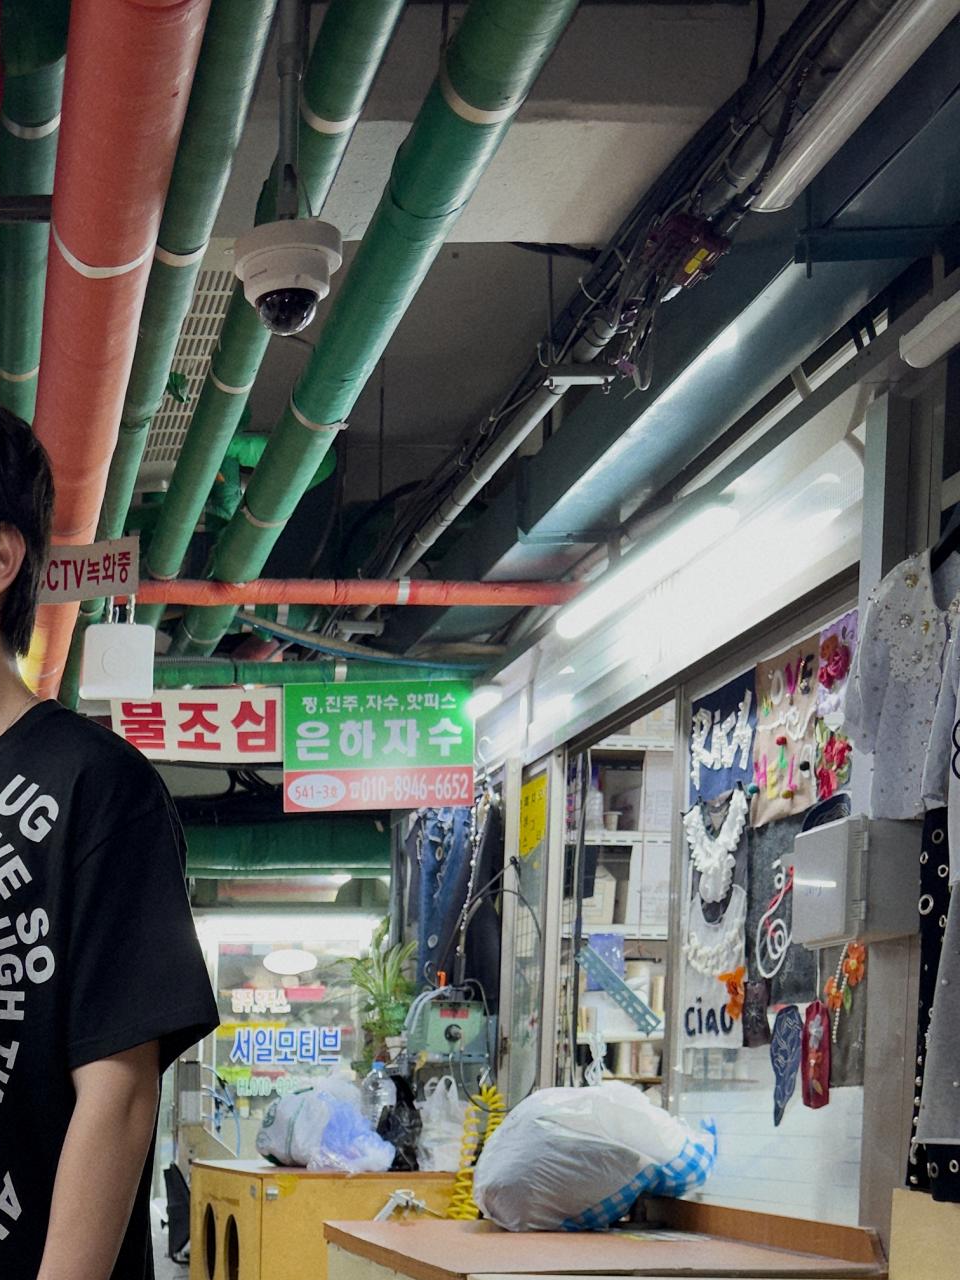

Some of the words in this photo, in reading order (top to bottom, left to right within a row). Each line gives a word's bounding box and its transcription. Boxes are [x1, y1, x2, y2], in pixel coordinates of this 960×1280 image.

[40, 551, 131, 593] CTV녹화중
[120, 700, 277, 753] 불조심
[296, 717, 463, 761] 은하자수
[361, 774, 469, 802] 010-8946-6652
[15, 907, 56, 984] SO
[231, 1028, 342, 1064] 서일모티브
